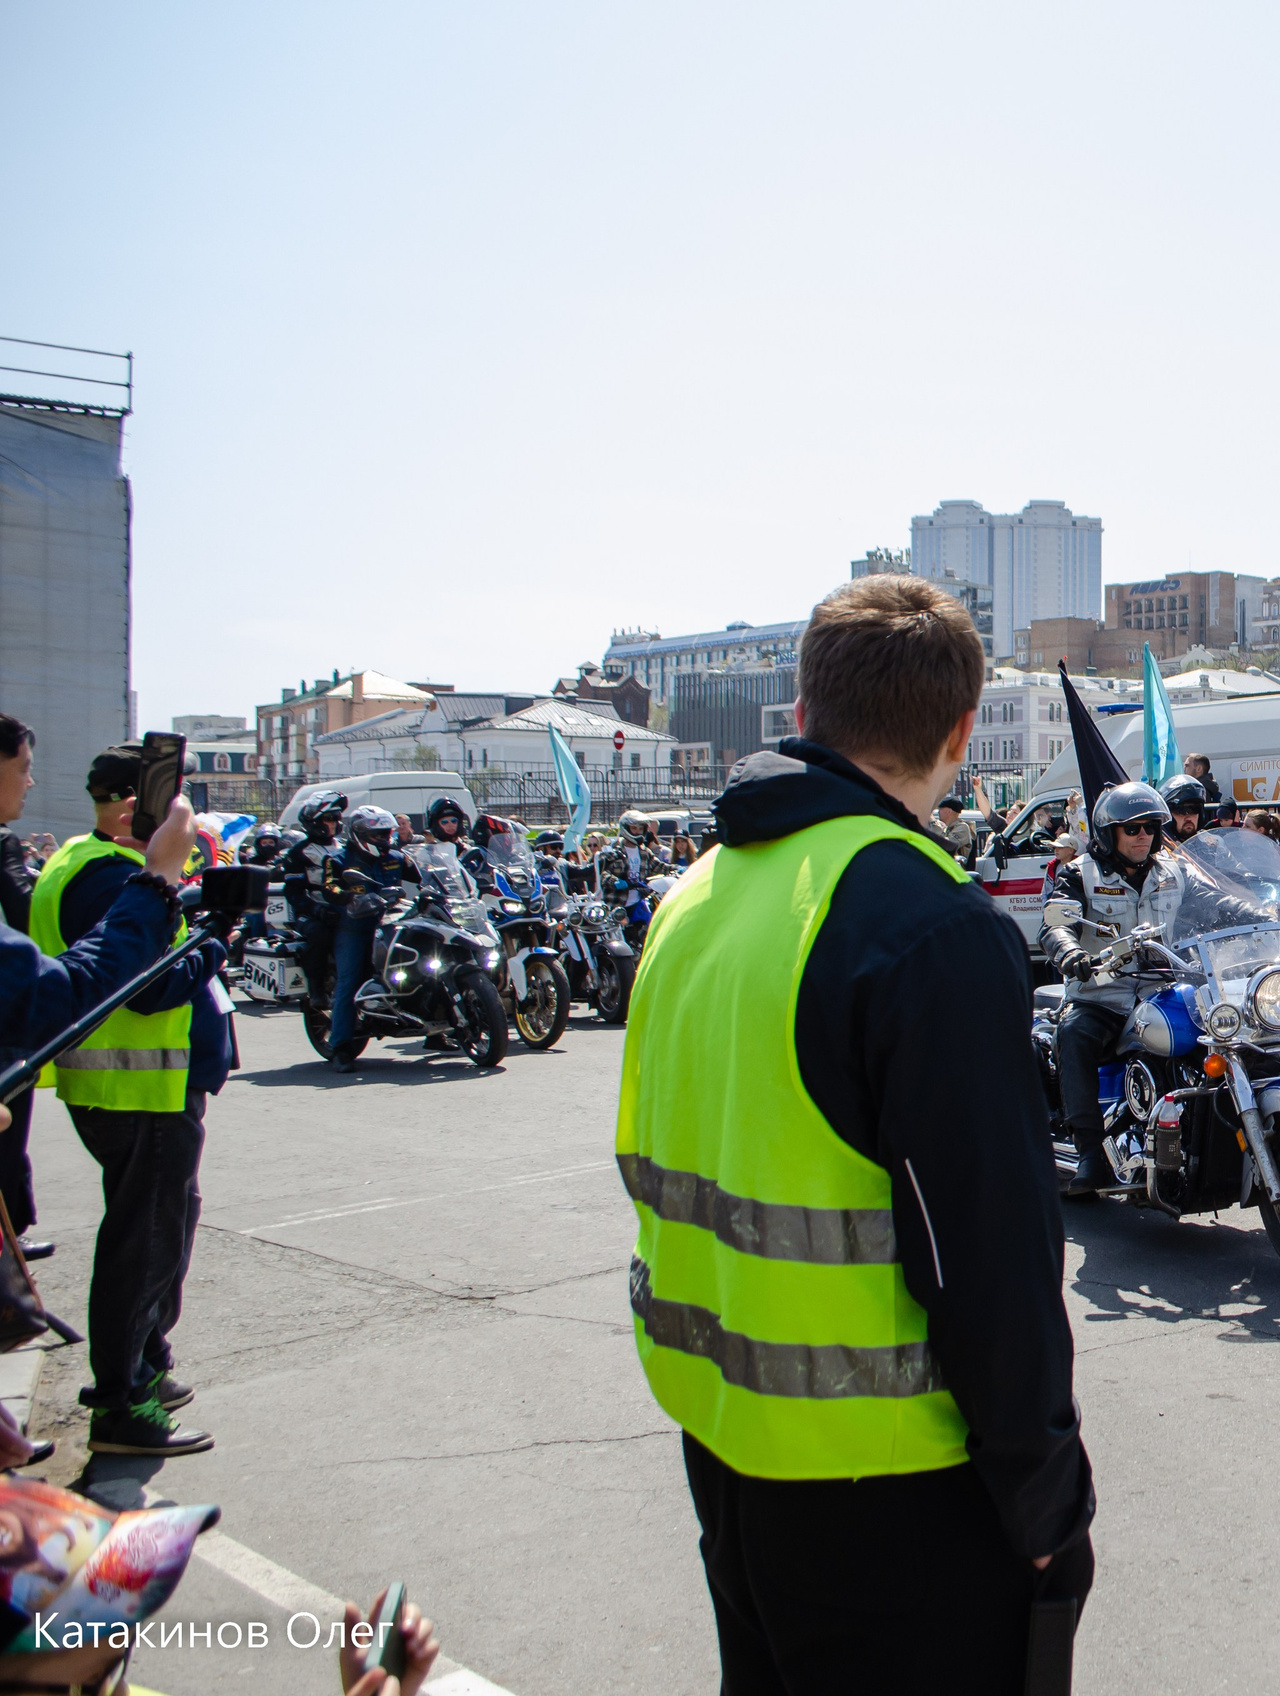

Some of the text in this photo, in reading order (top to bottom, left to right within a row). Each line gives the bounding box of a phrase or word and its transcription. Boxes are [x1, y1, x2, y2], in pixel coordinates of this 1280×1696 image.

[267, 901, 284, 915] GS
[1013, 905, 1042, 913] Владивост
[244, 963, 279, 995] BMW
